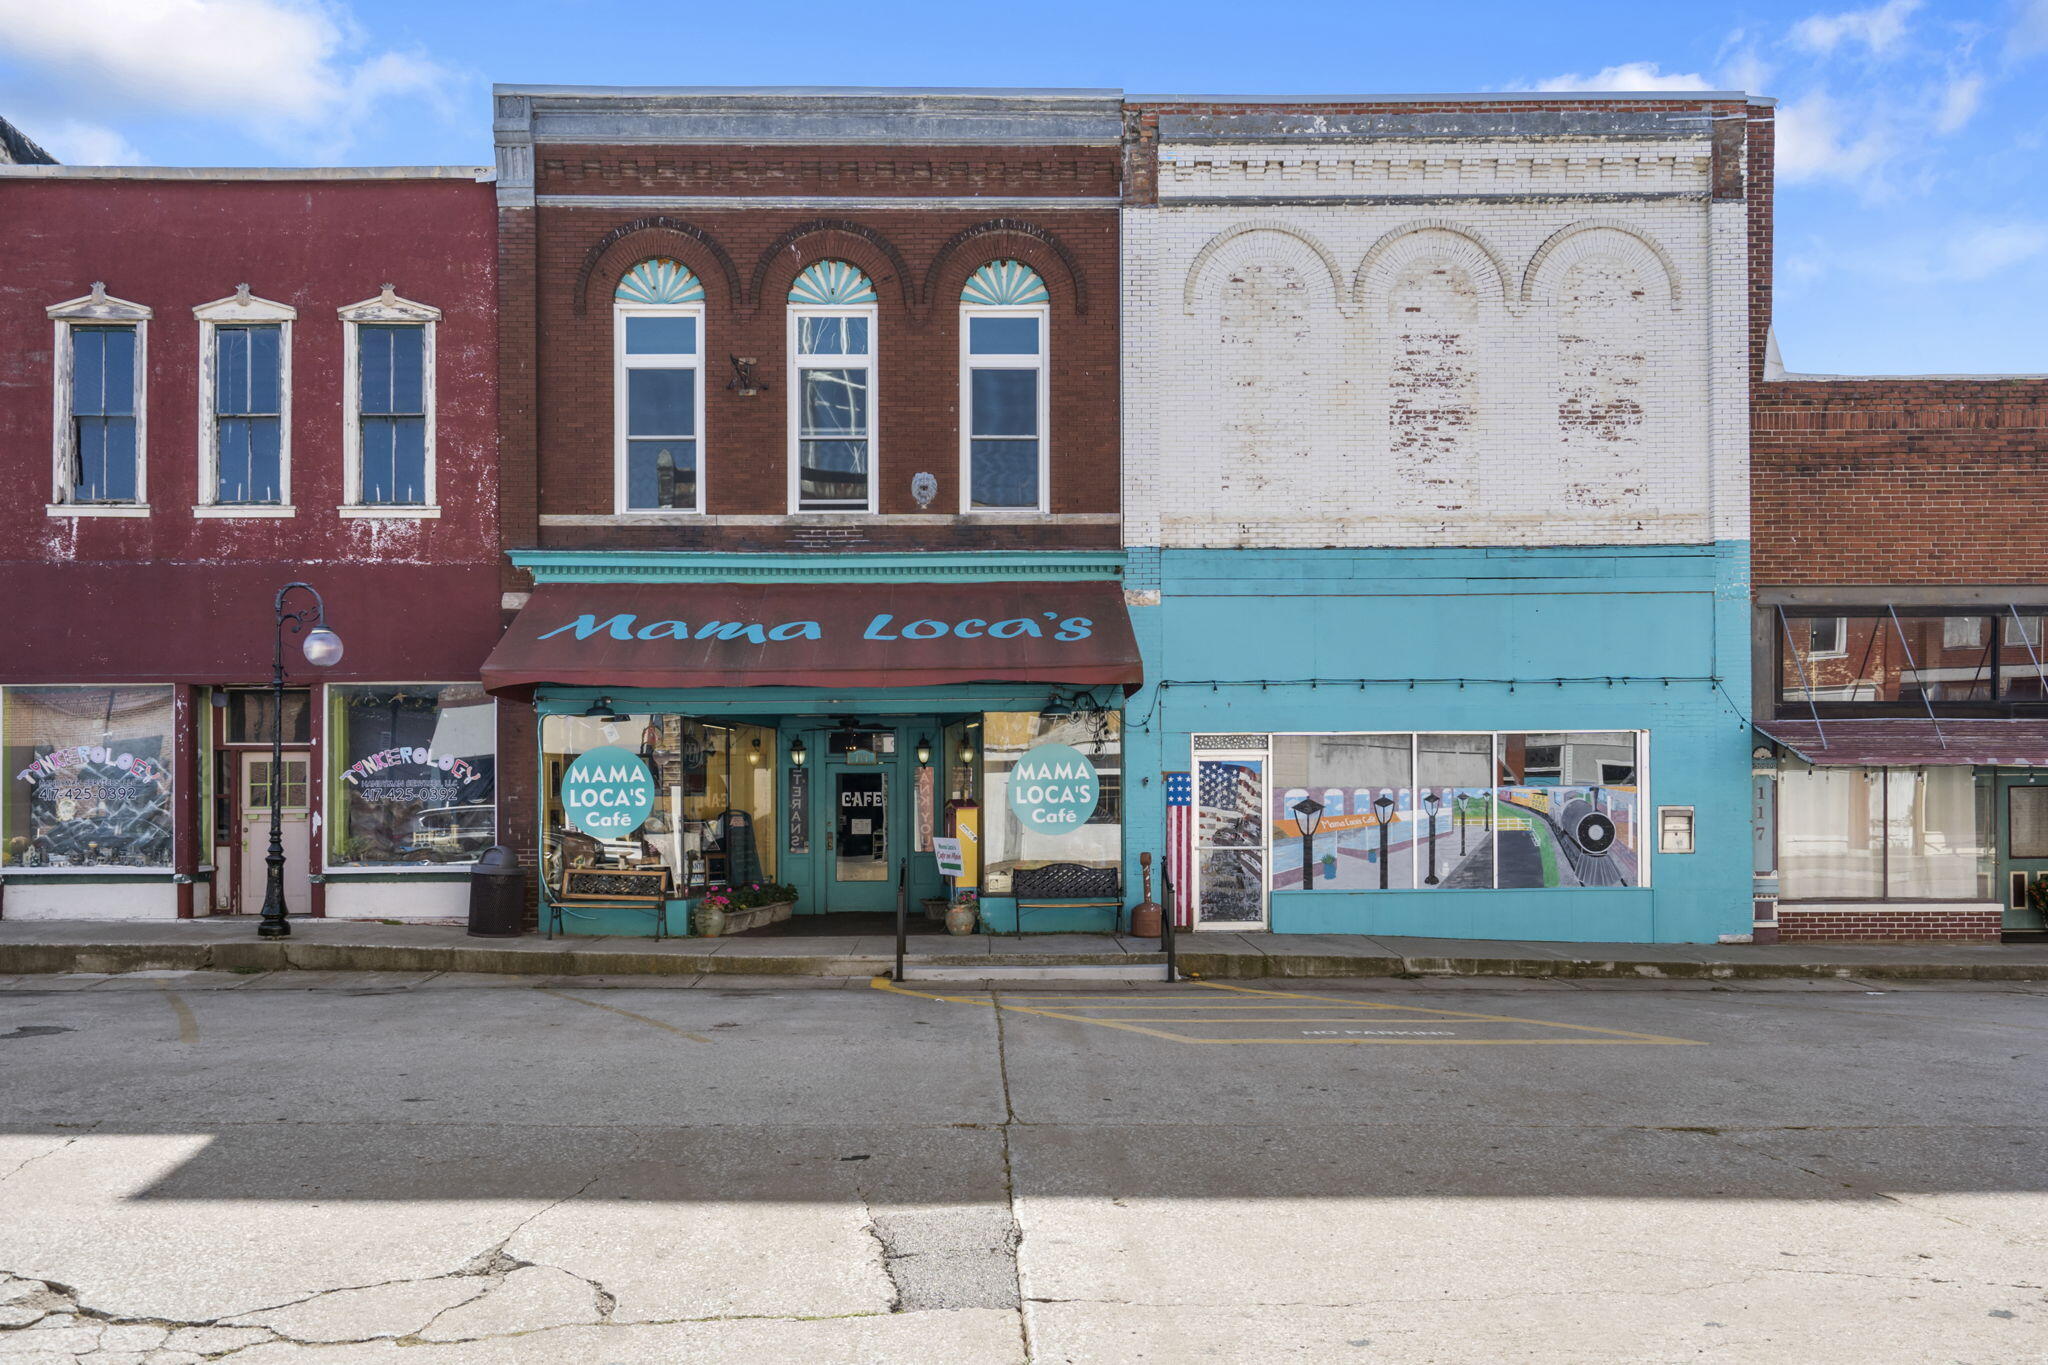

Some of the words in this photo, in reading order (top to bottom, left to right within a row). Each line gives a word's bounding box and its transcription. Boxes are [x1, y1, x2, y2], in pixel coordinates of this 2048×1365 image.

[537, 614, 822, 644] Mama
[863, 611, 1093, 641] Loca's
[16, 746, 161, 784] TINKEROLOGY
[339, 746, 481, 785] TINKEROLOGY
[570, 765, 646, 783] MAMA
[1016, 762, 1091, 780] MAMA
[38, 787, 137, 801] 417-425-0392
[360, 787, 458, 801] 417-425-0392
[569, 788, 647, 807] LOCA'S
[841, 791, 882, 807] CAFE
[1016, 785, 1092, 804] LOCA'S
[585, 811, 632, 827] Café
[1031, 808, 1077, 823] Café
[1755, 786, 1766, 841] 117
